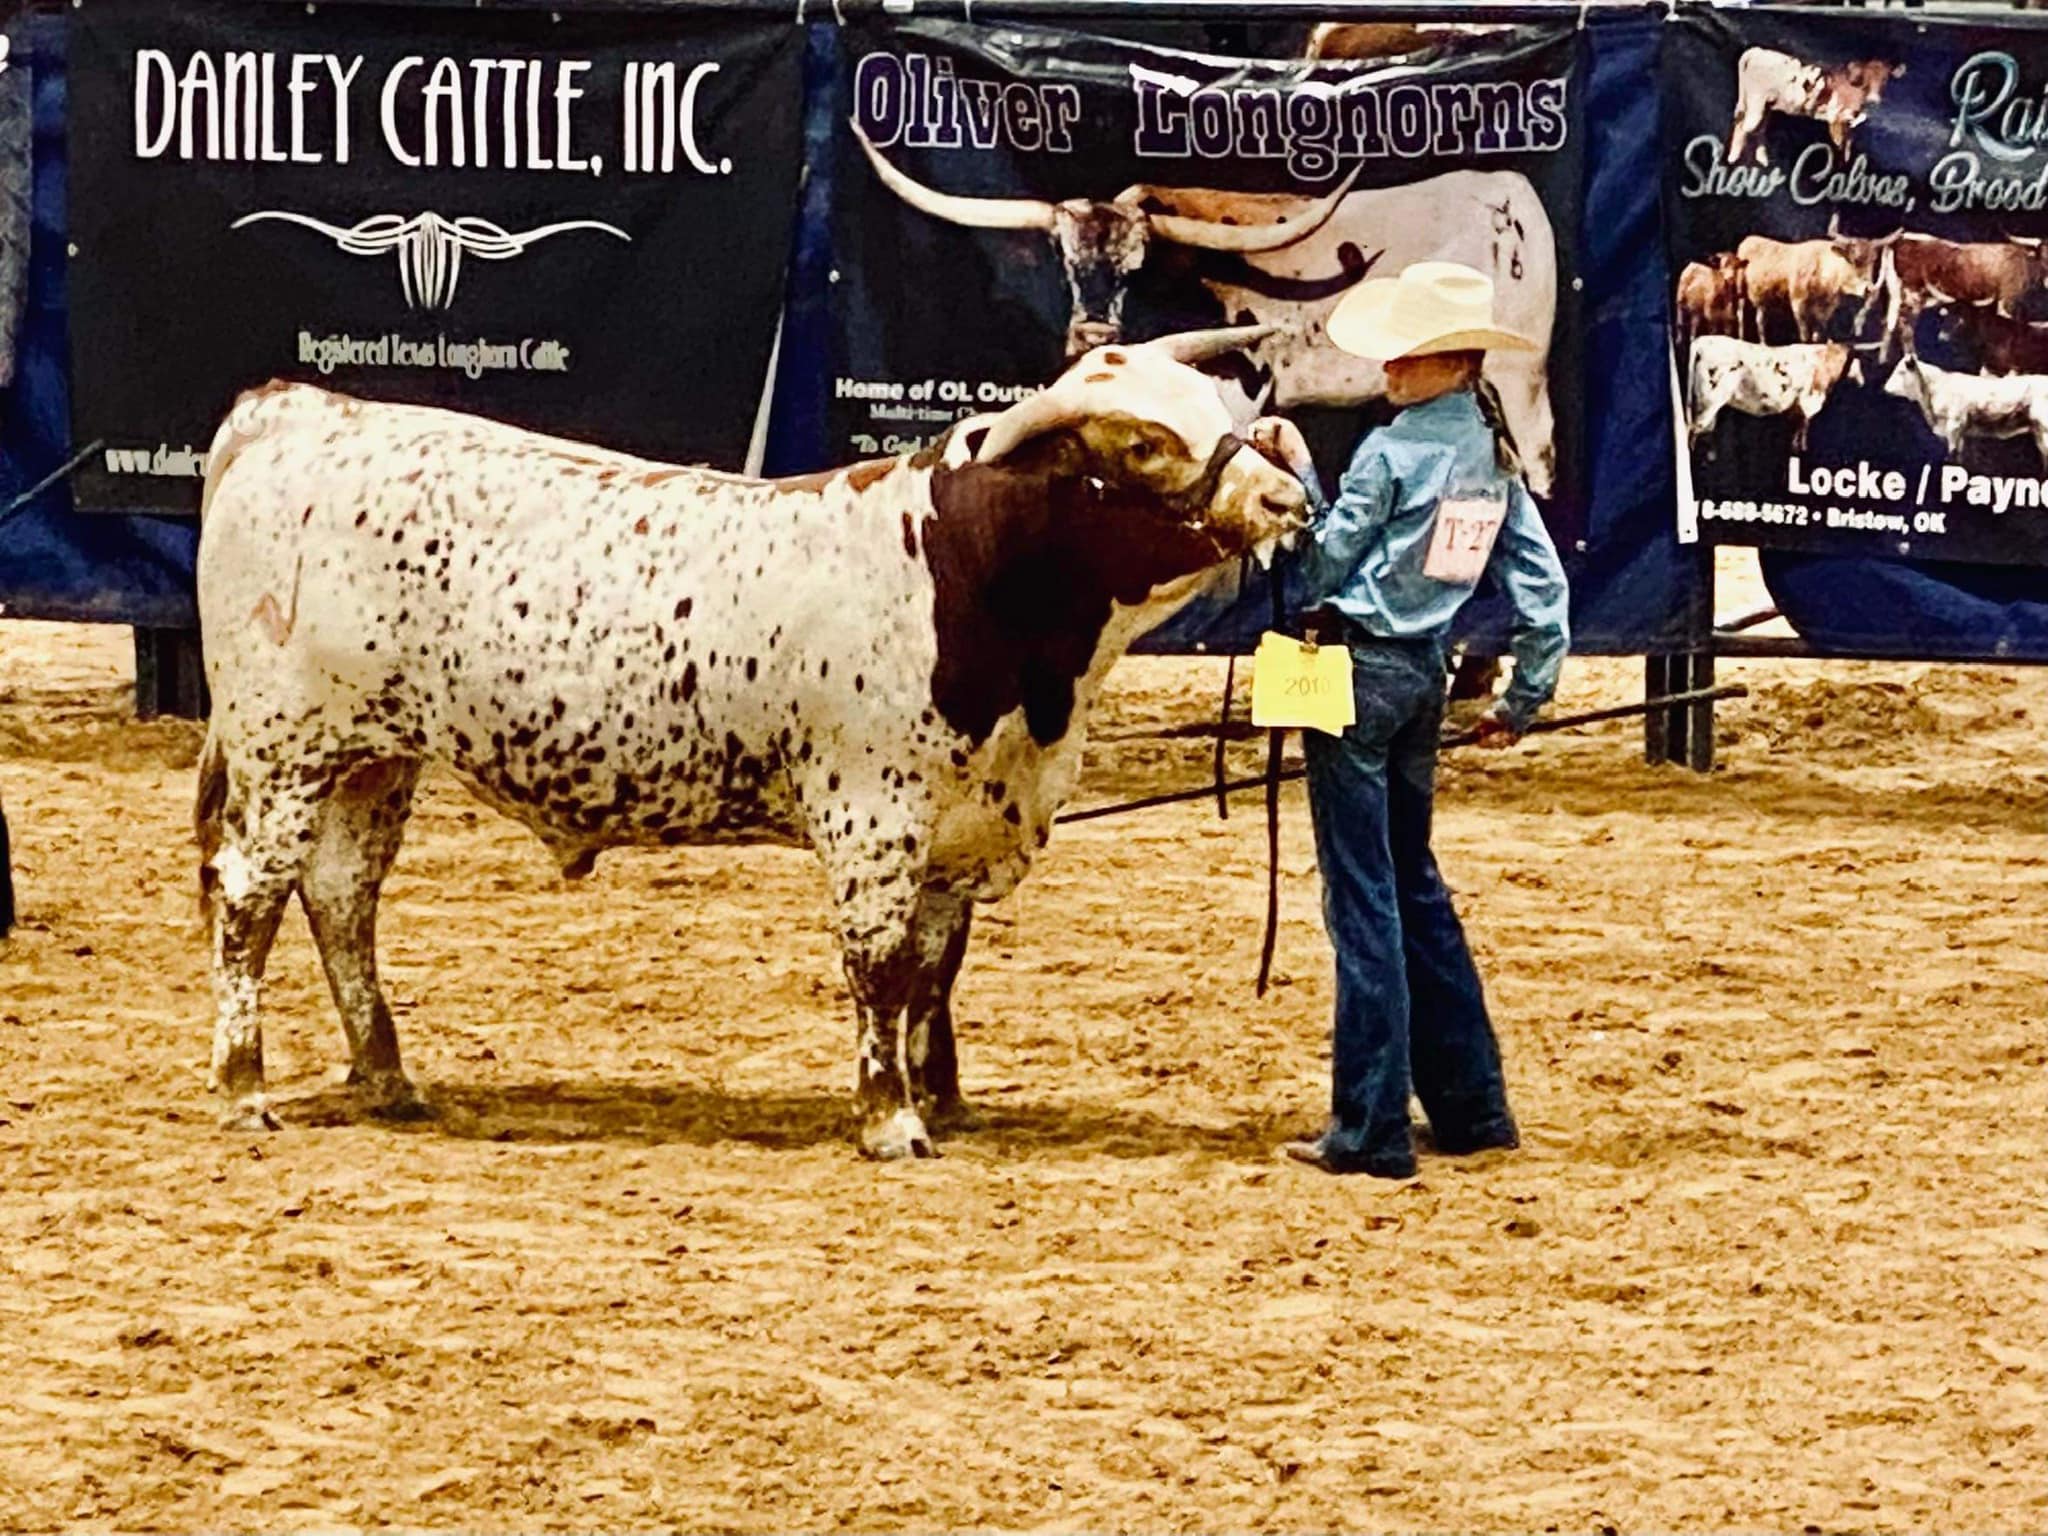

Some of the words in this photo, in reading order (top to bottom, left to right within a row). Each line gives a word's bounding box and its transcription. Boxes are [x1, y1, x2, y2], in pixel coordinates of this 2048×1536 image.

[135, 49, 363, 163] DANLEY
[381, 56, 602, 176] CATTLE,
[625, 61, 732, 174] INC.
[854, 52, 1080, 152] Oliver
[1133, 74, 1568, 181] Longhorns
[1682, 134, 1786, 197] Show
[1790, 142, 1916, 213] Calves,
[1930, 151, 2048, 213] Brood
[835, 377, 904, 400] Home
[908, 380, 934, 401] of
[938, 381, 974, 402] OL
[1788, 456, 1906, 500] Locke
[1826, 507, 1909, 535] Bristow,
[1914, 512, 1947, 533] OK
